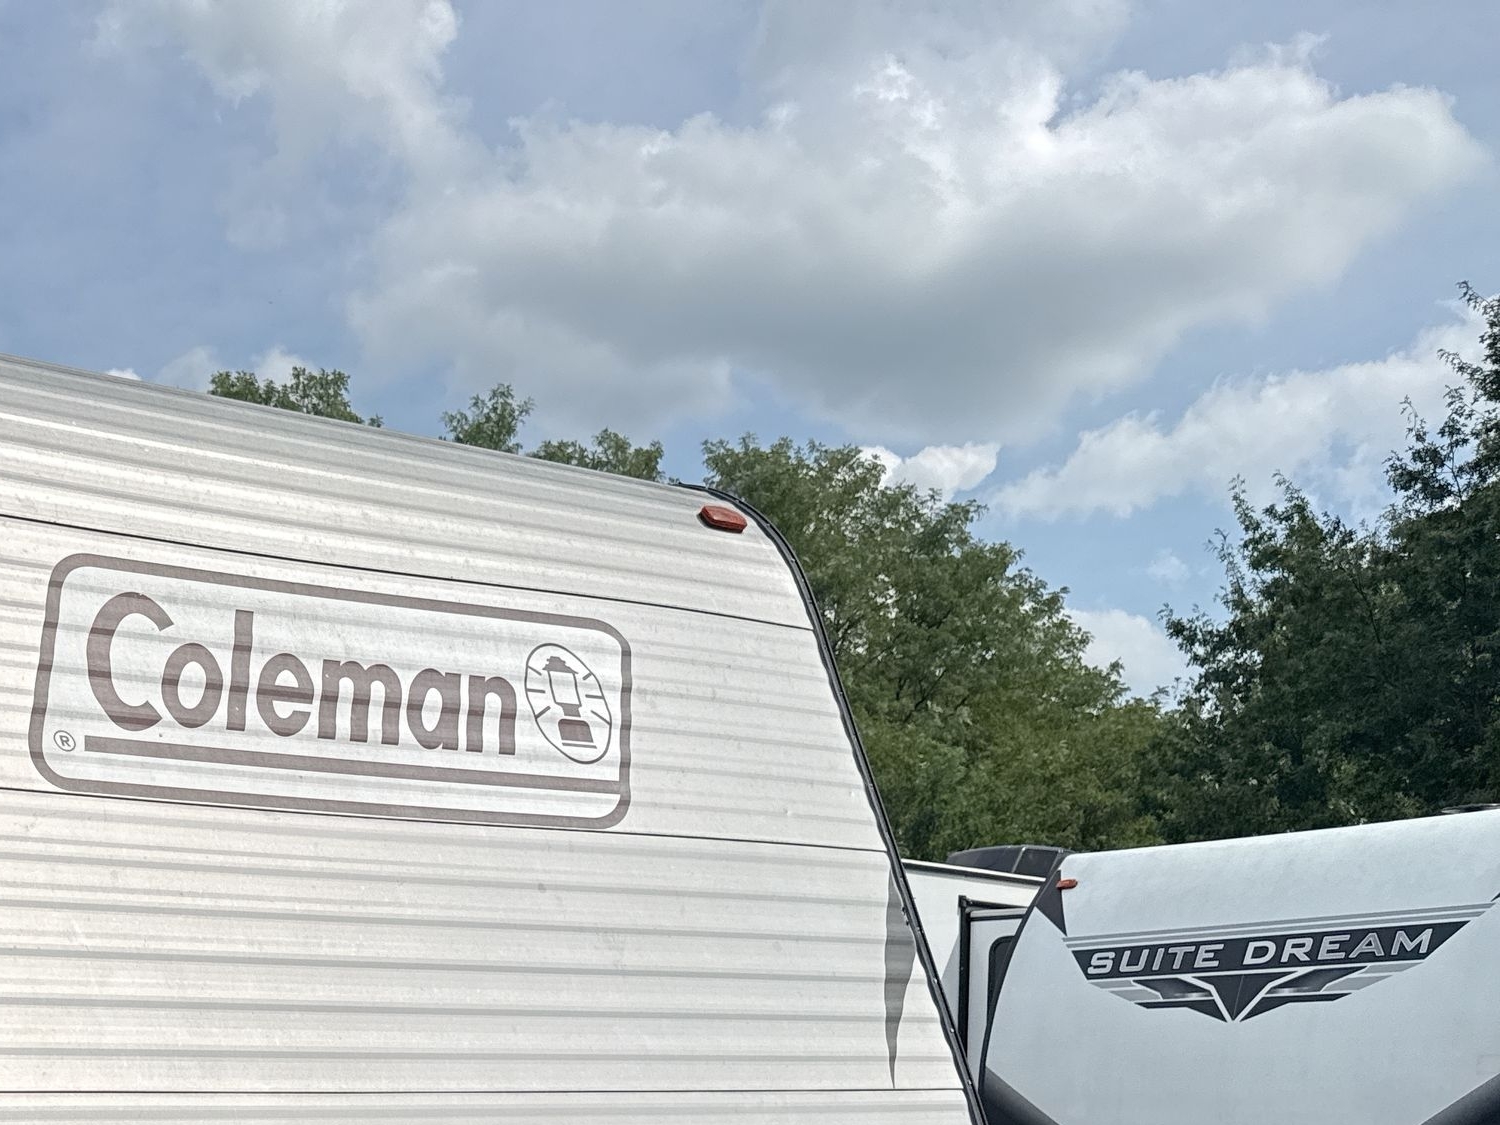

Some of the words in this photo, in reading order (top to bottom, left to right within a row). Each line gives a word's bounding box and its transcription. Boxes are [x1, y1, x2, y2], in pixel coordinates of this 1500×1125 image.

[86, 591, 518, 756] Coleman
[1087, 943, 1225, 975] SUITE
[1242, 928, 1434, 966] DREAM
